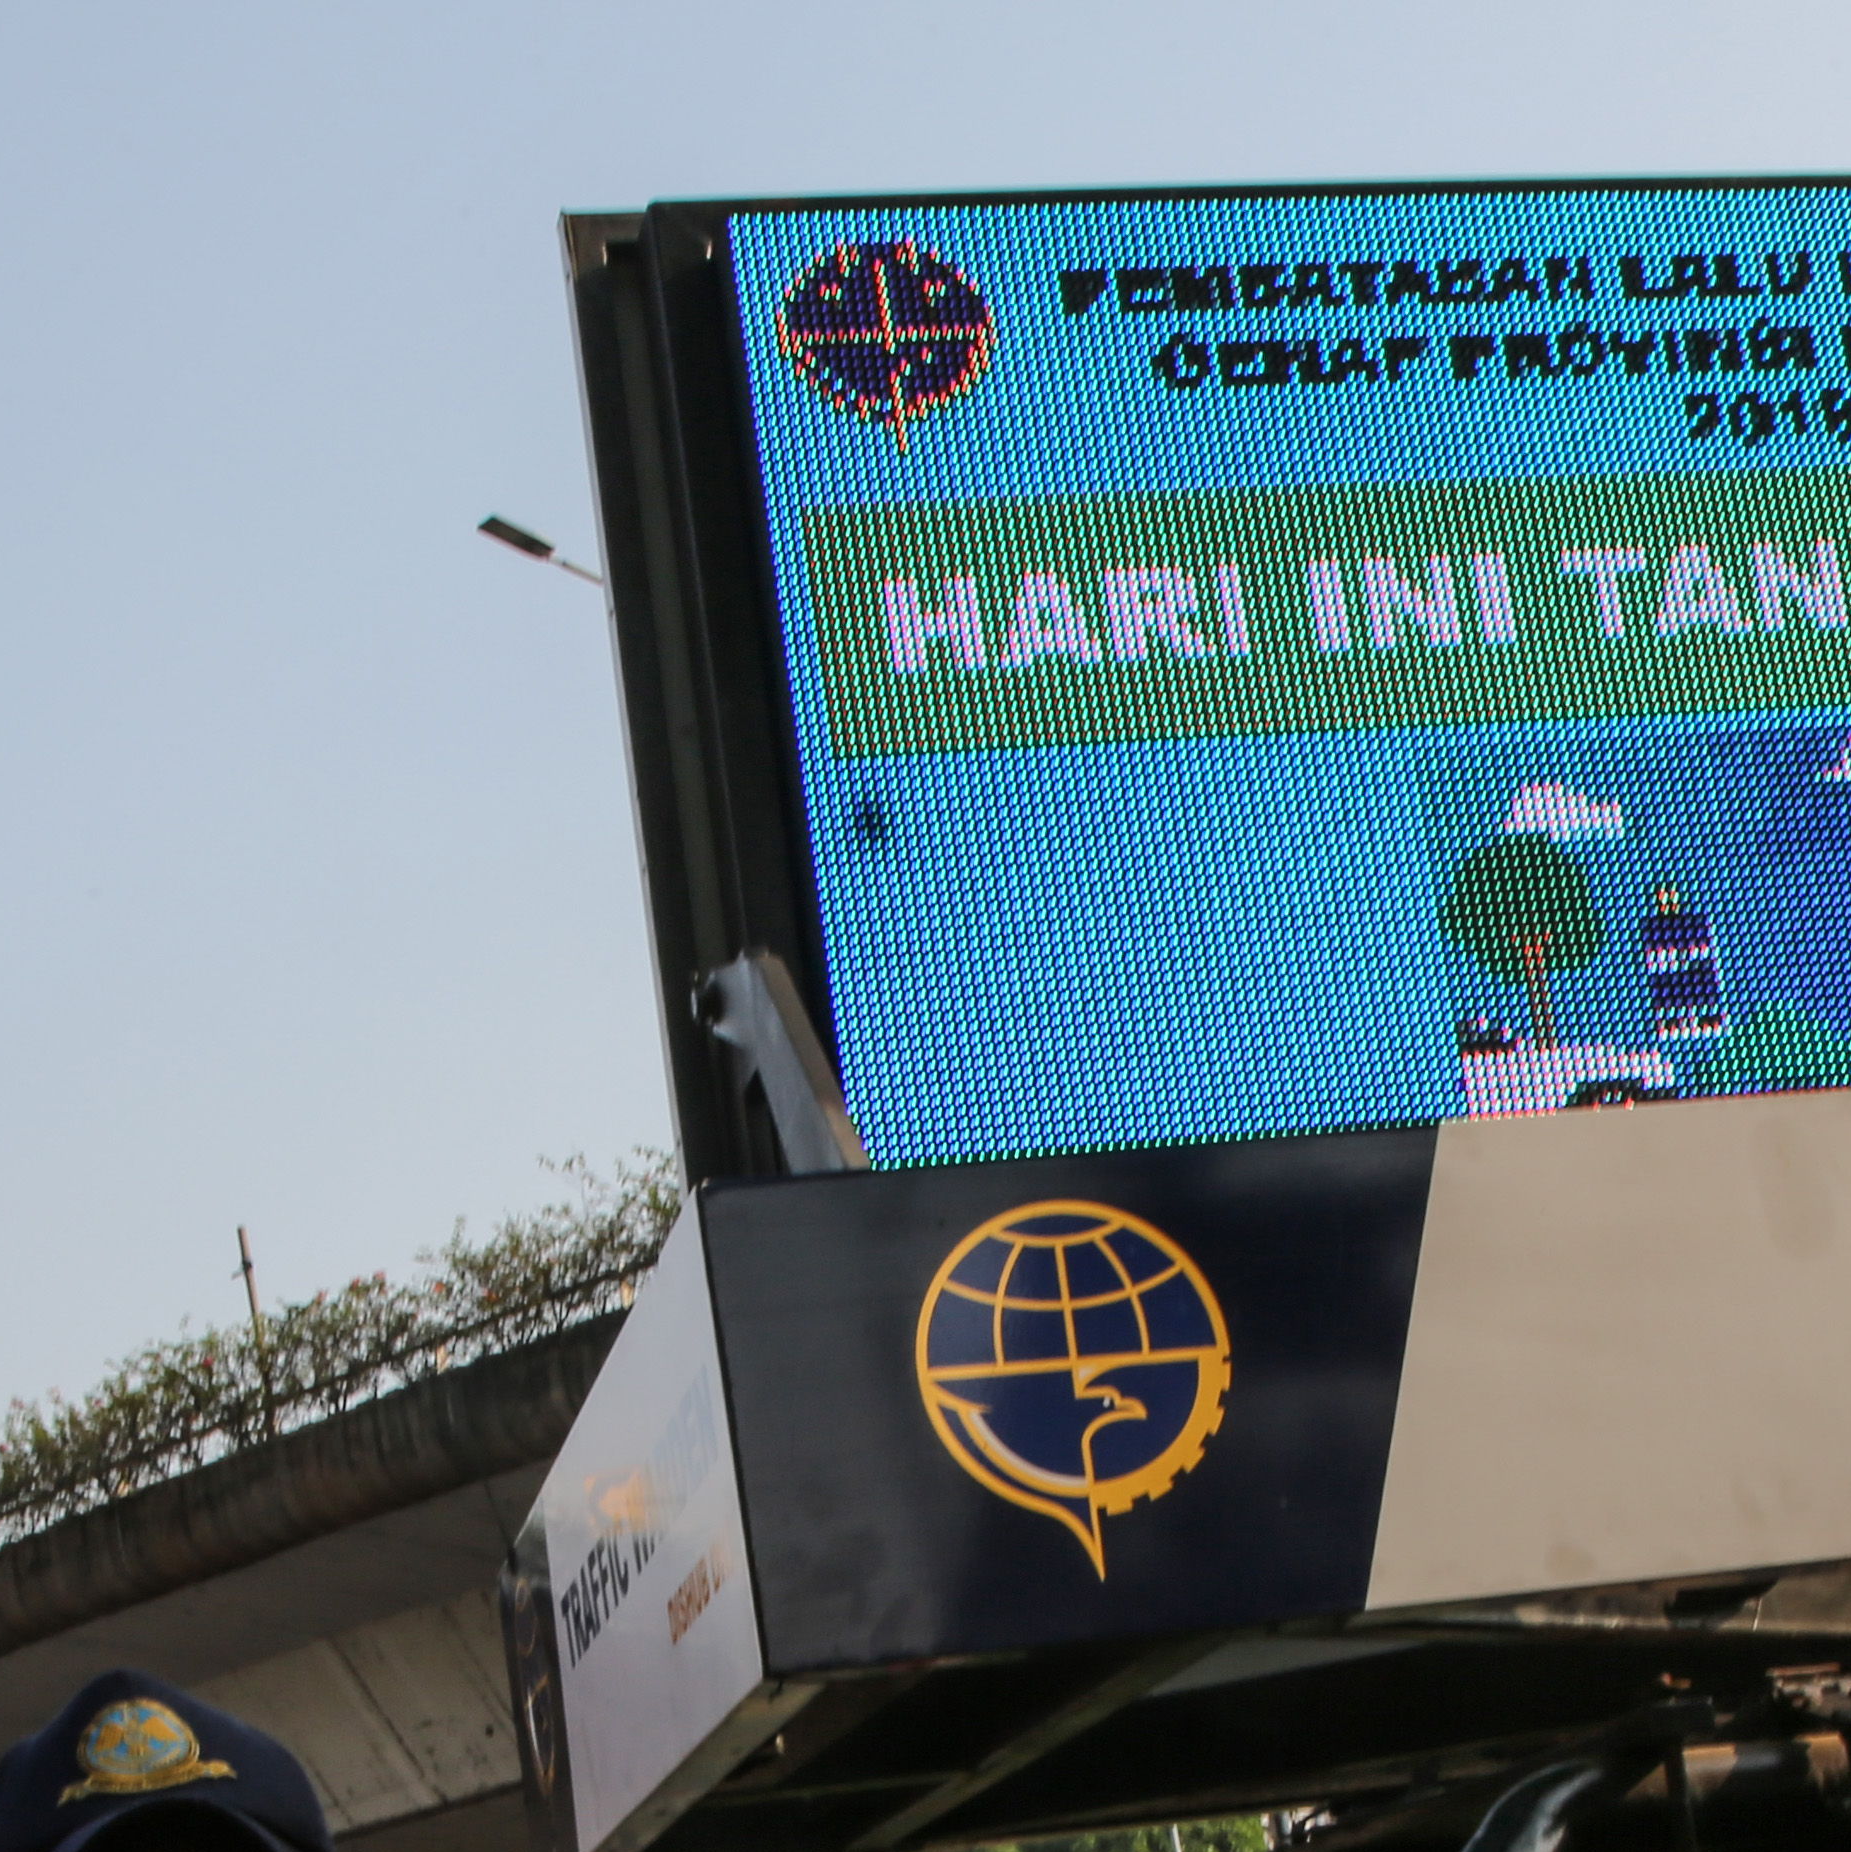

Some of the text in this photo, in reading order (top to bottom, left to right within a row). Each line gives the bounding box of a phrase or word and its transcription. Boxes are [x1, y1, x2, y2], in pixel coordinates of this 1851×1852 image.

[1621, 247, 1816, 301] LALU
[880, 558, 1252, 676] HARI
[1305, 549, 1517, 655] INI
[560, 1528, 631, 1670] TRAFFIC
